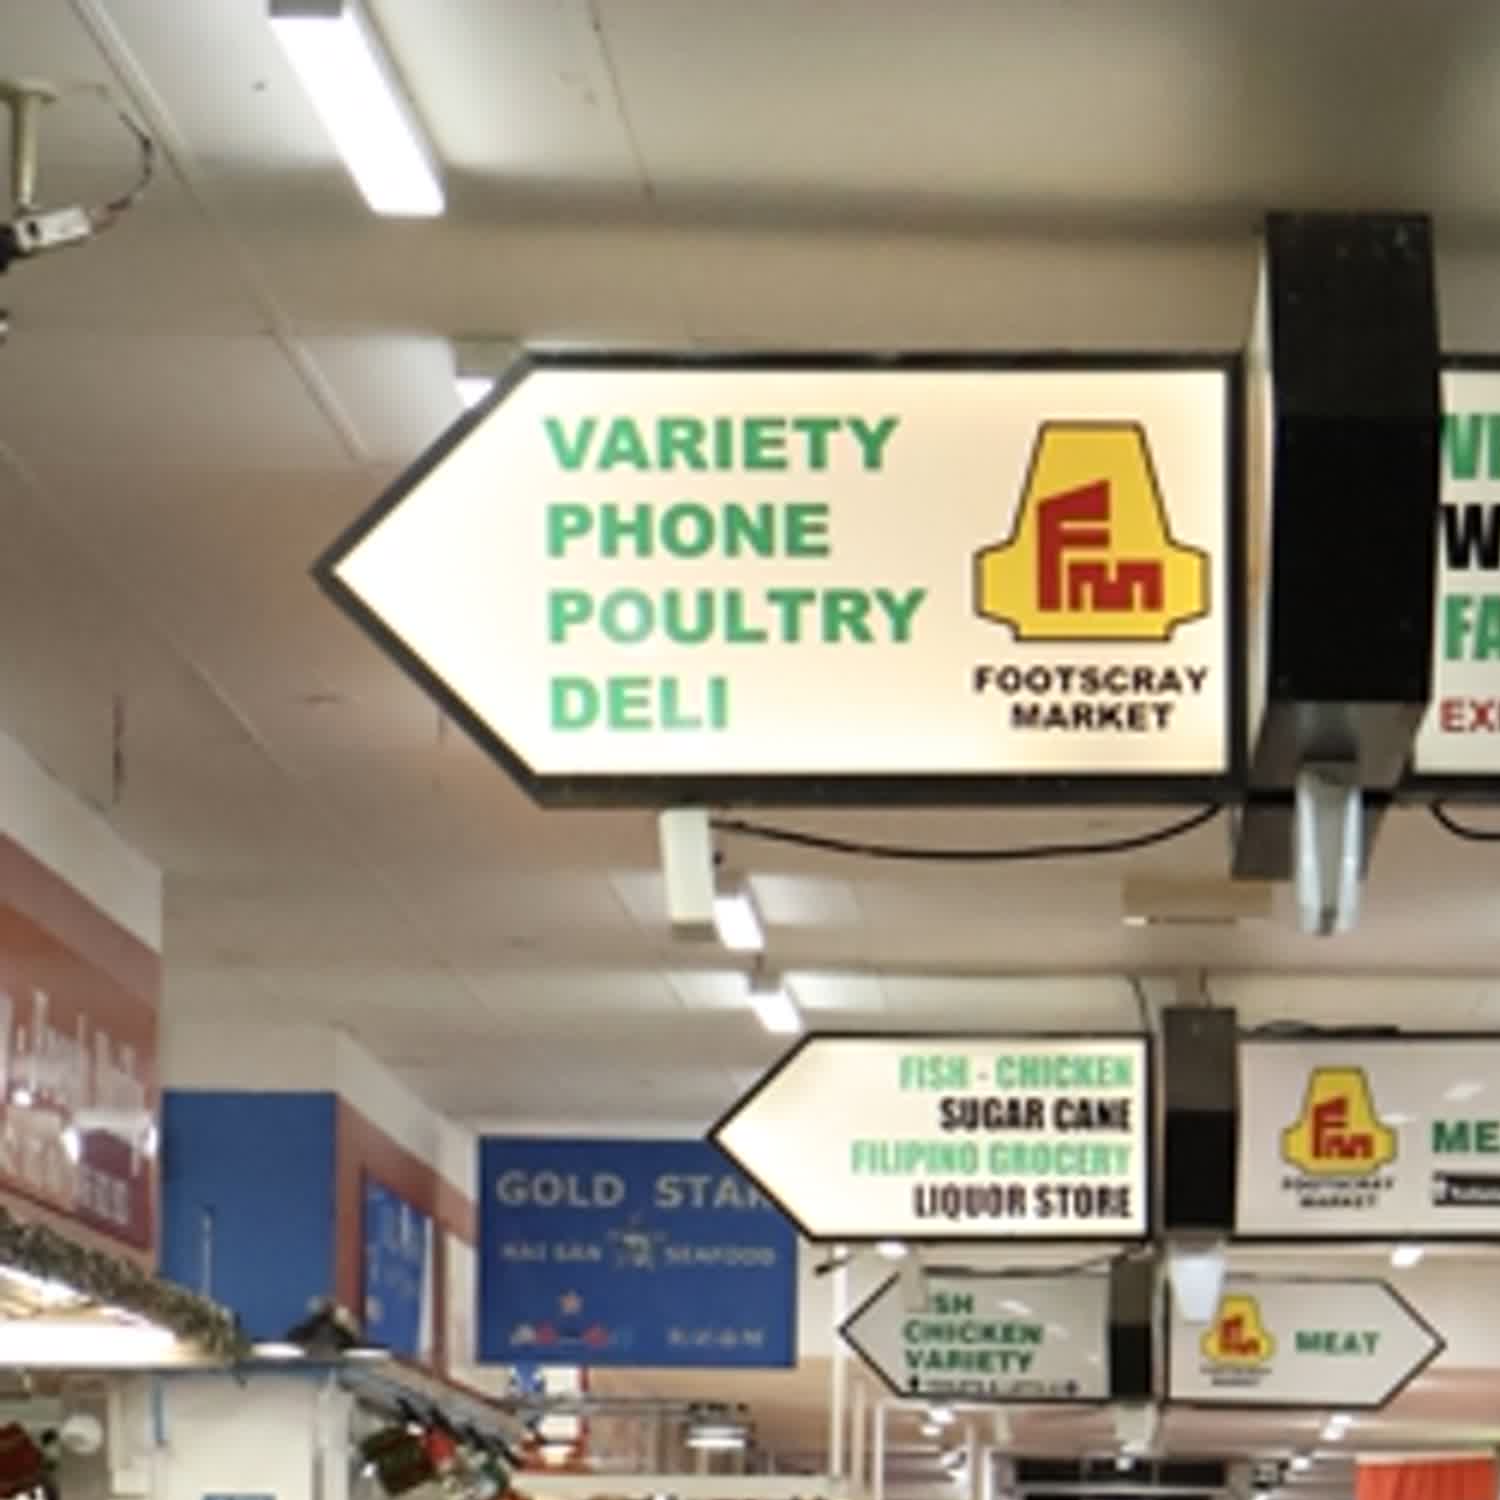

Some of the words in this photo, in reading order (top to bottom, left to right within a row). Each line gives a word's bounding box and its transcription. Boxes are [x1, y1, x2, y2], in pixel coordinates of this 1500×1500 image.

[544, 416, 899, 471] VARIETY
[546, 503, 831, 559] PHONE
[547, 589, 927, 643] POULTRY
[973, 666, 1208, 694] FOOTSCRAY
[550, 676, 729, 730] DELI
[1010, 703, 1172, 731] MARKET
[900, 1056, 968, 1088] FISH
[996, 1056, 1134, 1088] CHICKEN
[939, 1098, 1045, 1131] SUGAR
[1053, 1098, 1132, 1132] CANE
[851, 1142, 979, 1174] FILIPINO
[988, 1142, 1132, 1175] GROCERY
[497, 1171, 625, 1206] GOLD
[914, 1184, 1027, 1219] LIQUOR
[1034, 1184, 1132, 1218] STORE
[904, 1320, 1044, 1344] CHICKEN
[1295, 1332, 1380, 1356] MEAT
[905, 1350, 1034, 1373] VARIETY
